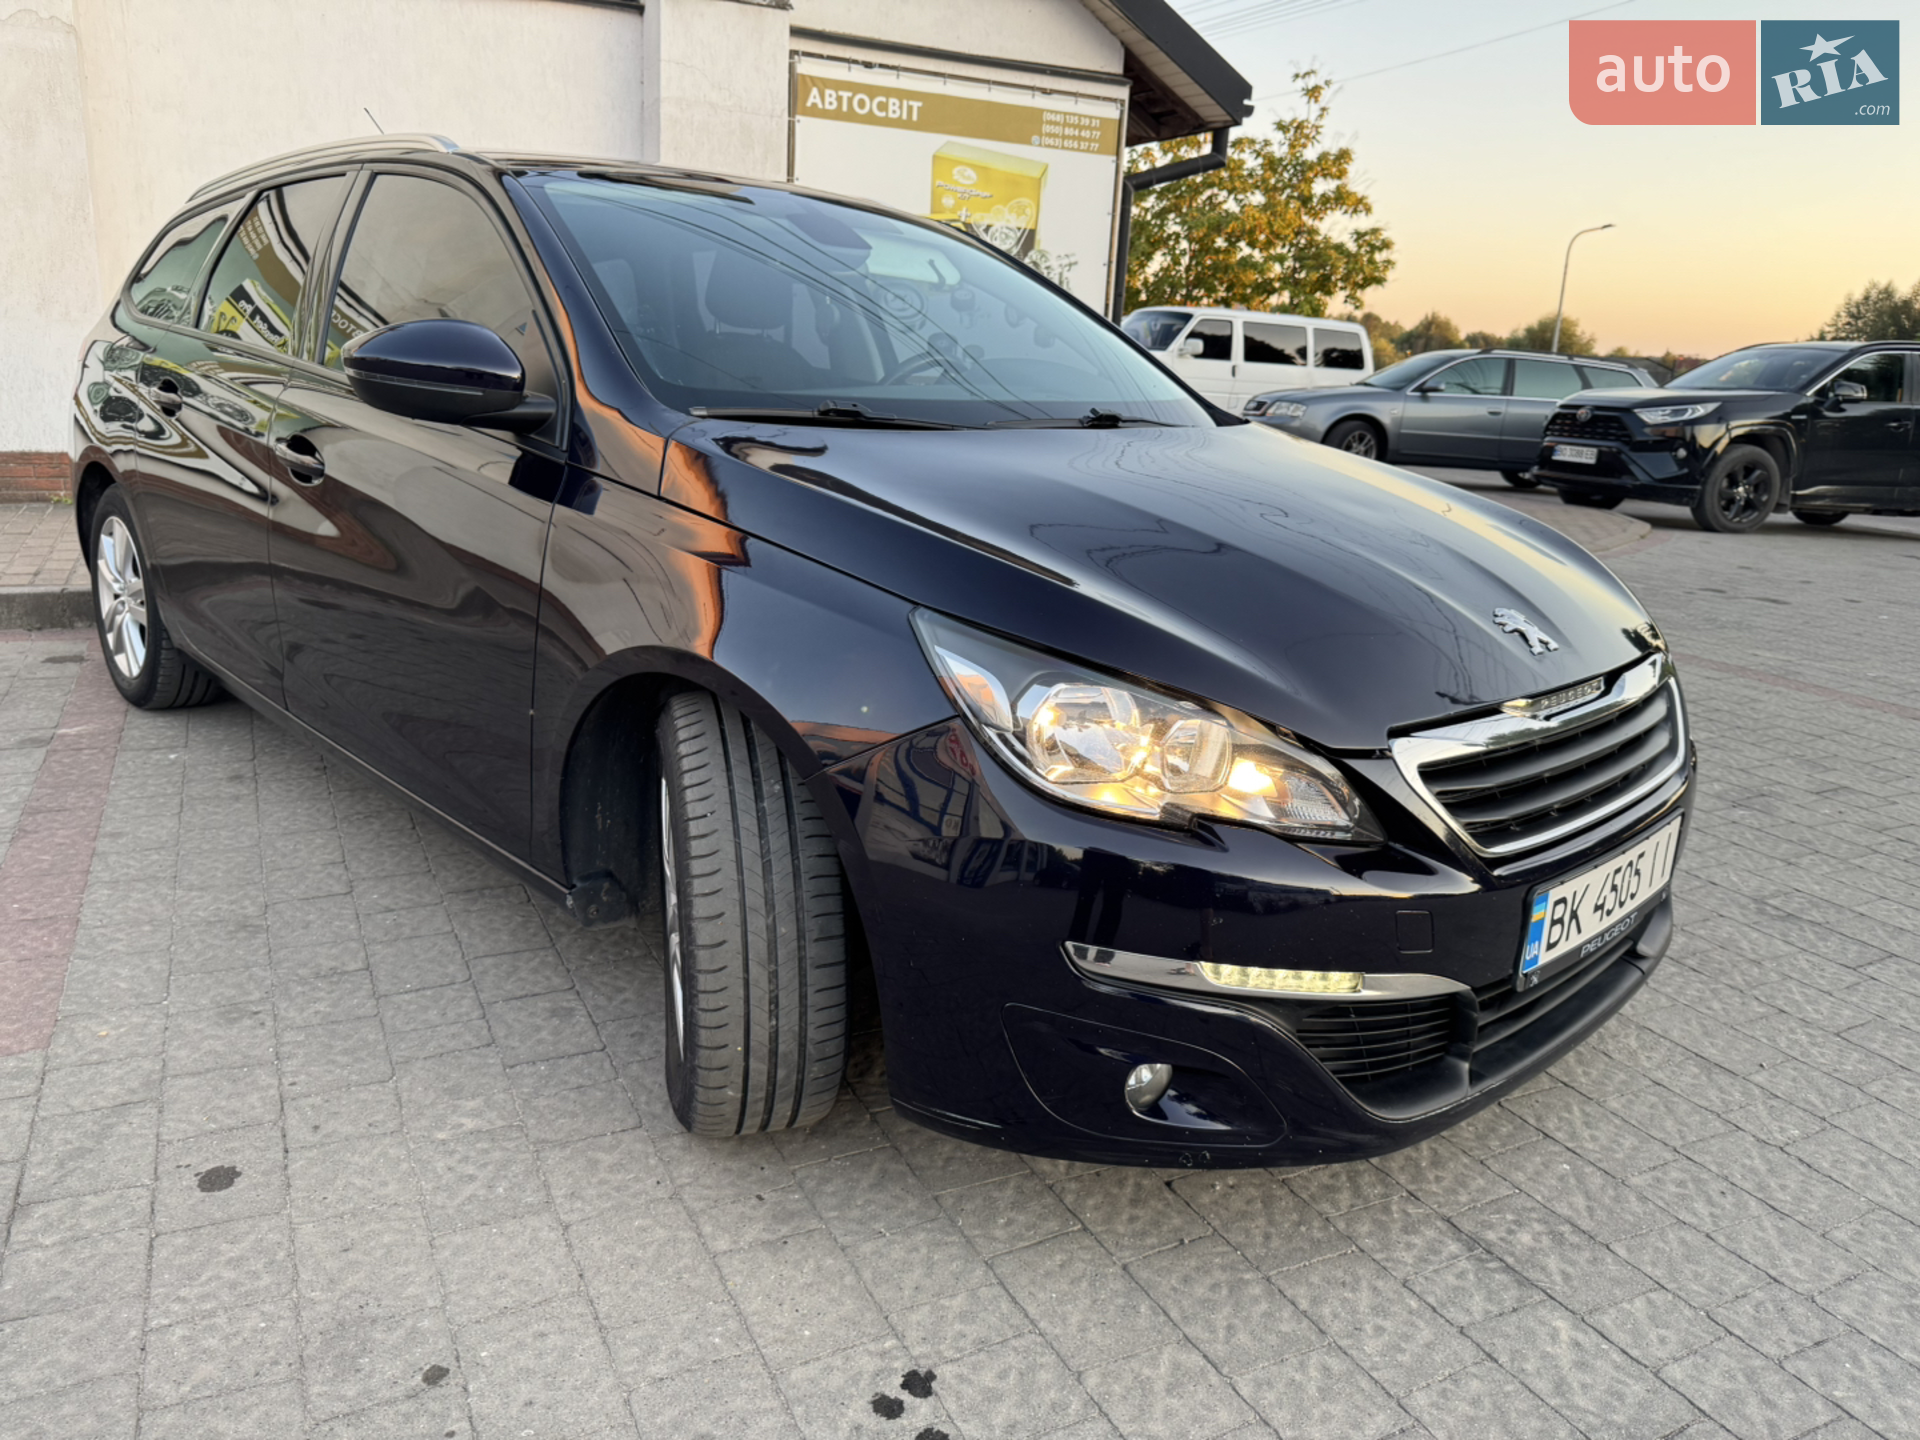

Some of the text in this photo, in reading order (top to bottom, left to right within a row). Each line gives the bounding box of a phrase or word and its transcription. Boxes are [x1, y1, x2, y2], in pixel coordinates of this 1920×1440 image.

[805, 86, 923, 122] АВТОСВІТ
[1090, 143, 1100, 151] 77
[1091, 131, 1101, 140] 77
[1541, 682, 1598, 709] PEUGEOT
[1545, 883, 1590, 952] BK
[1593, 851, 1645, 922] 4505
[1580, 912, 1638, 958] PEUGEOT
[1525, 941, 1539, 960] UA
